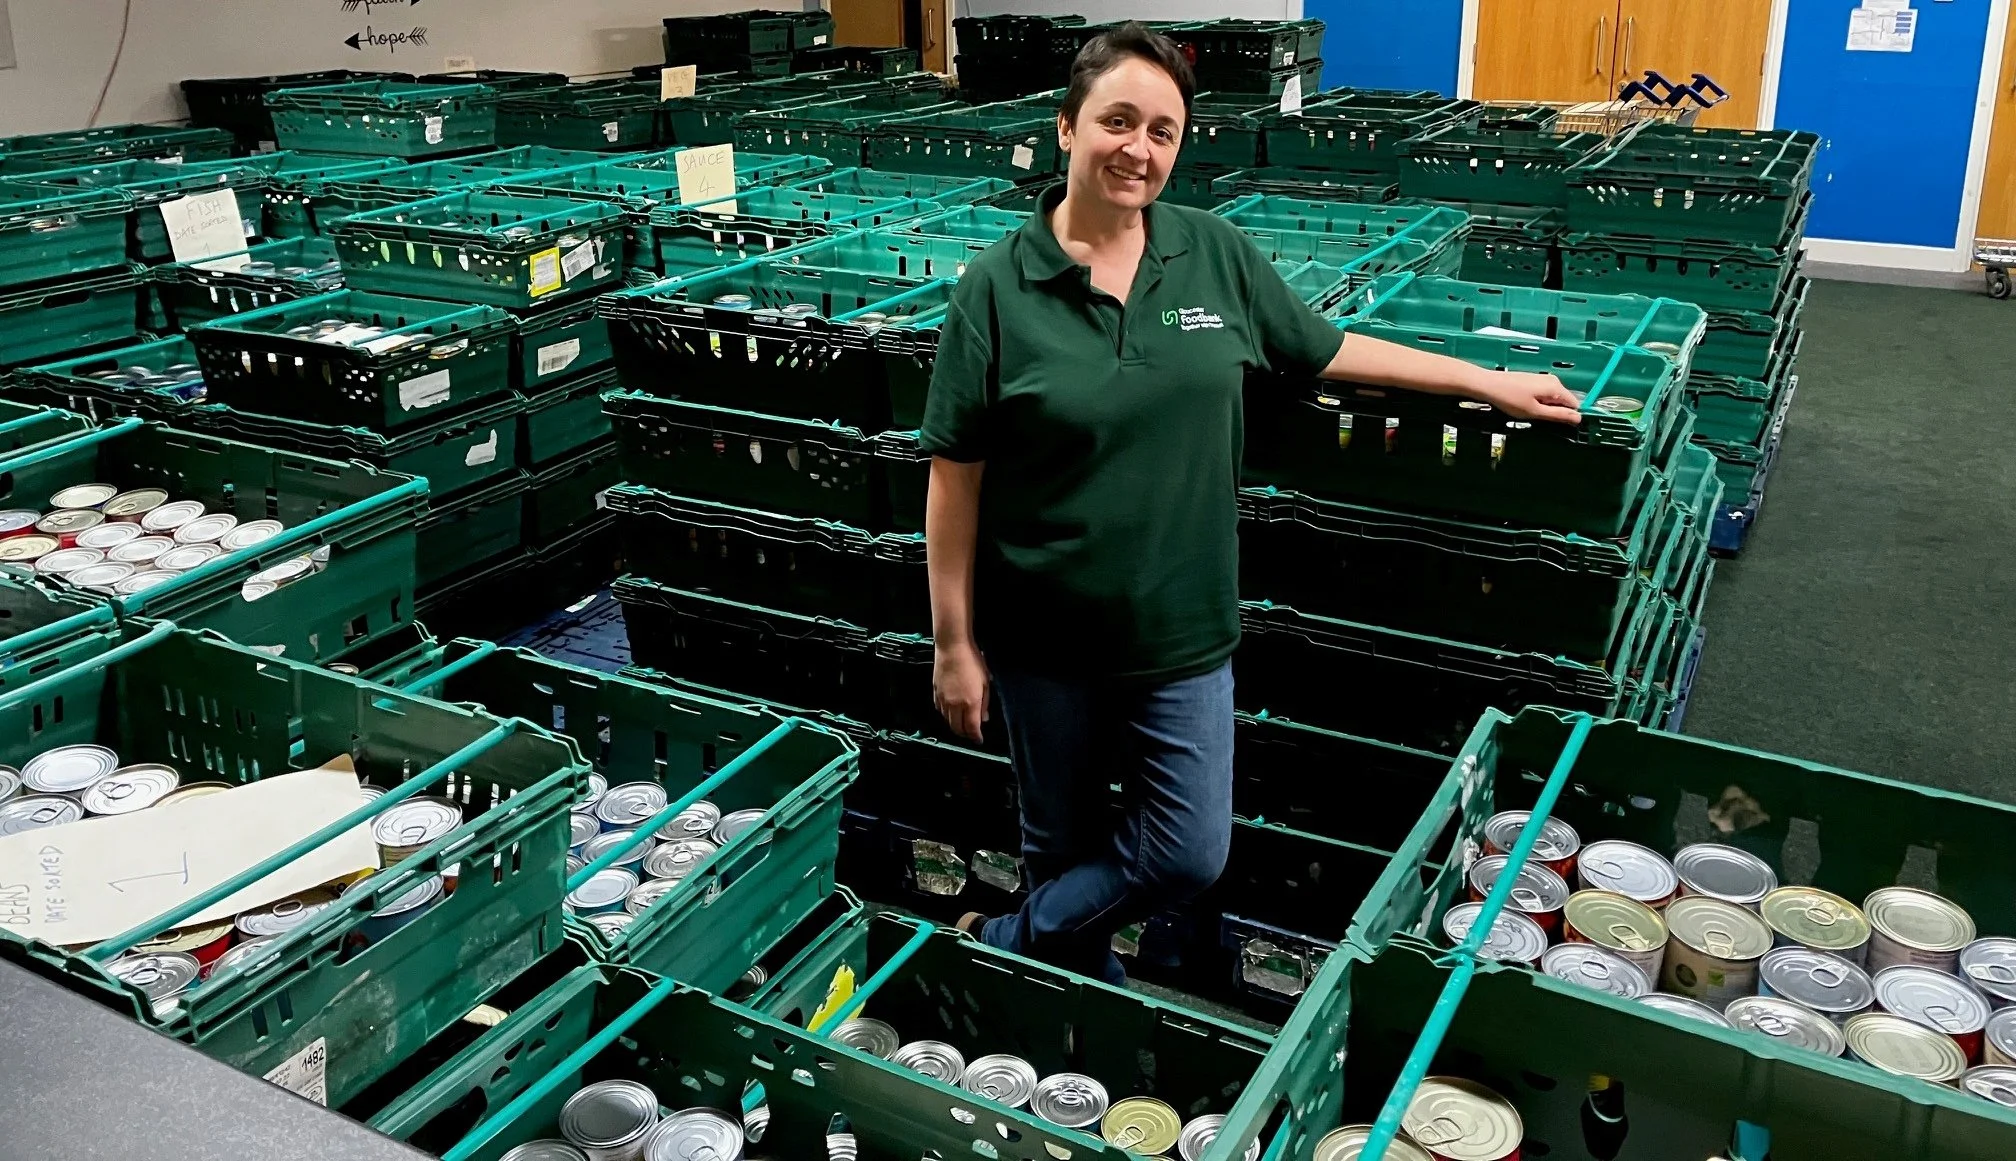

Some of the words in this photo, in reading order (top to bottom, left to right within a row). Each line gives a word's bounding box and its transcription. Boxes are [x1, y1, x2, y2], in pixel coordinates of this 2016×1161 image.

[367, 25, 407, 54] hope
[683, 150, 725, 174] SAUCE
[699, 175, 716, 197] 4
[185, 199, 222, 221] FISH
[173, 225, 197, 241] DATE
[1180, 313, 1223, 325] Foodbank
[38, 845, 65, 891] SORTED
[0, 882, 31, 925] BEANS
[44, 897, 68, 925] DATE
[301, 1046, 324, 1071] 1482
